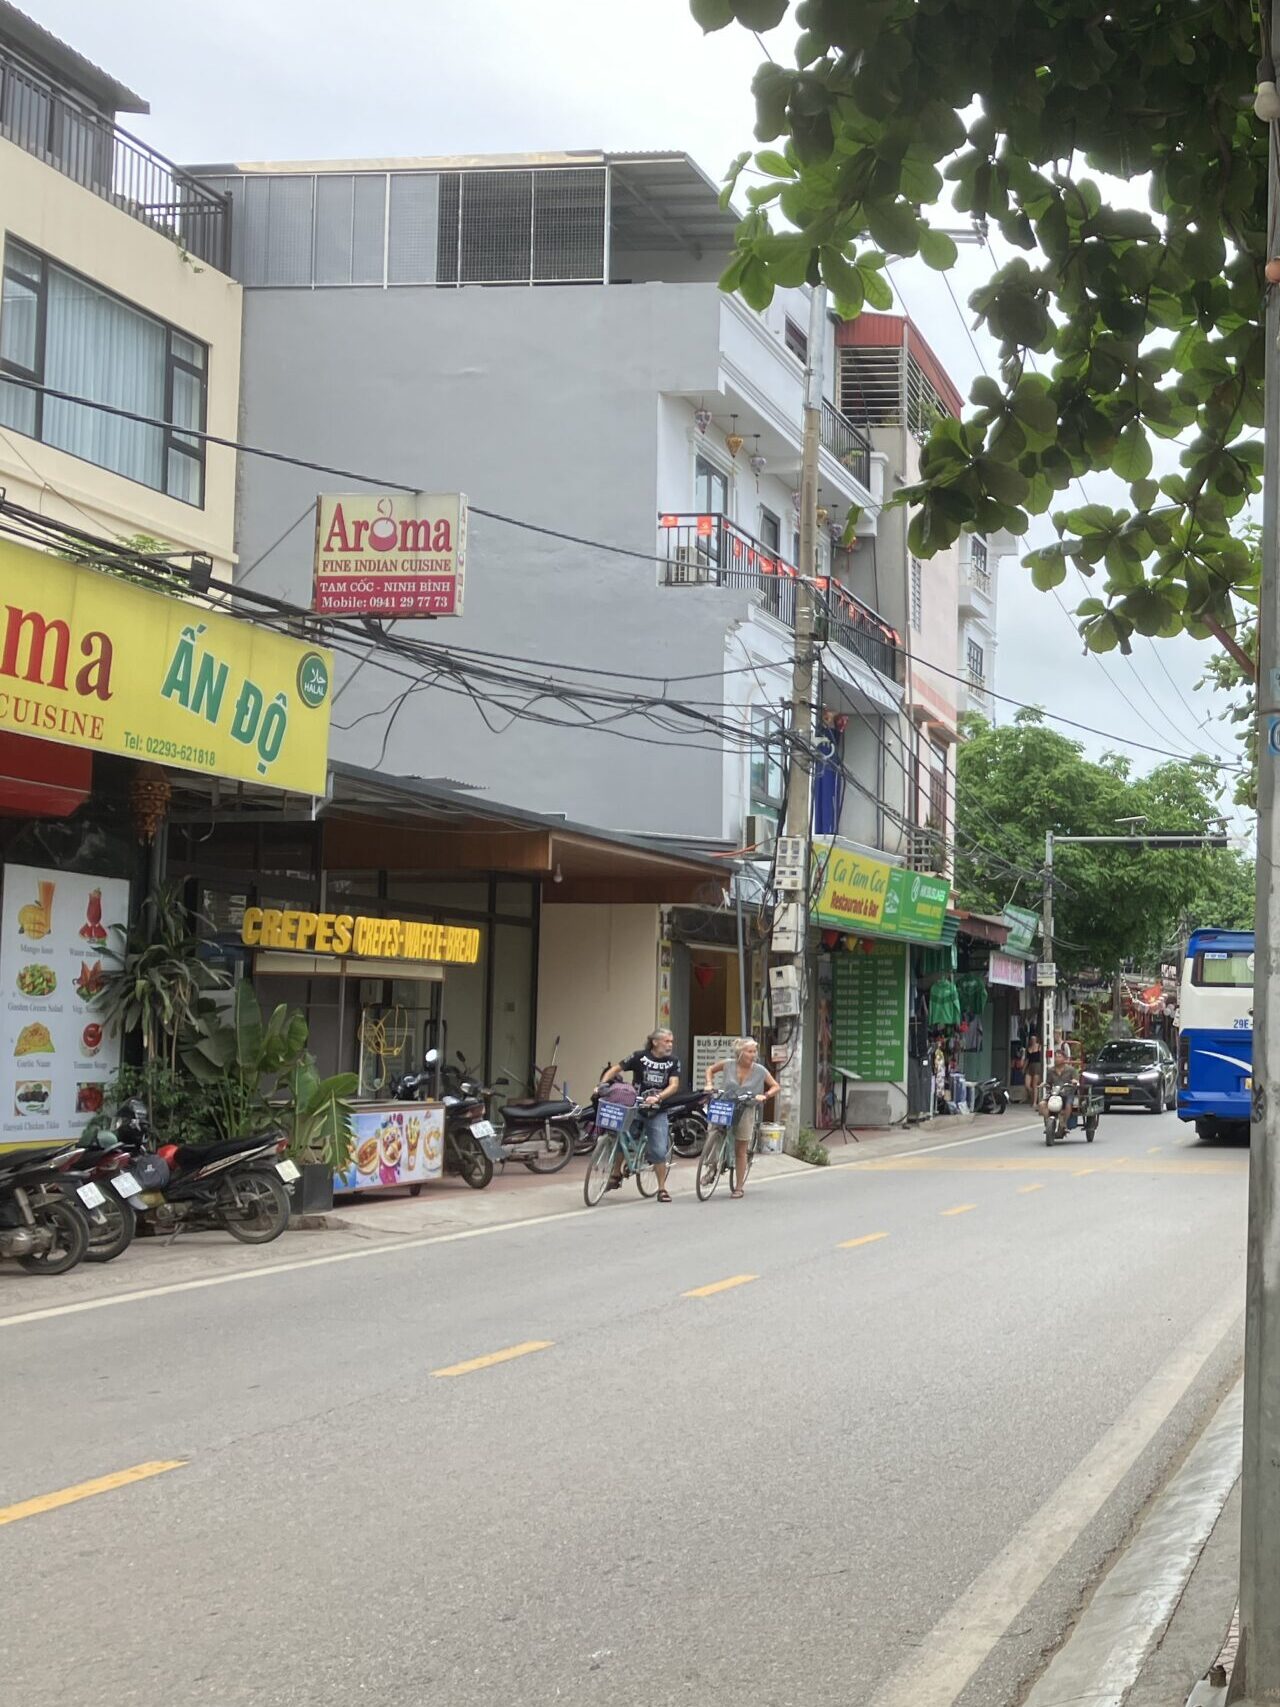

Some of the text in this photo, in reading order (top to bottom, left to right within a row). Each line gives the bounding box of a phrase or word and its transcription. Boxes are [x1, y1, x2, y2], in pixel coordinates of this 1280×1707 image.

[322, 559, 451, 573] FINE INDIAN CUISINE
[320, 582, 346, 592] TAM
[384, 582, 416, 592] NINH
[322, 597, 448, 608] Mobile: 0941 29 77 73
[304, 682, 324, 696] HALAL
[161, 624, 229, 724] ẤN
[230, 679, 287, 775] ĐỘ
[124, 732, 216, 767] Tel: 02293-621818
[241, 907, 354, 954] CREPES
